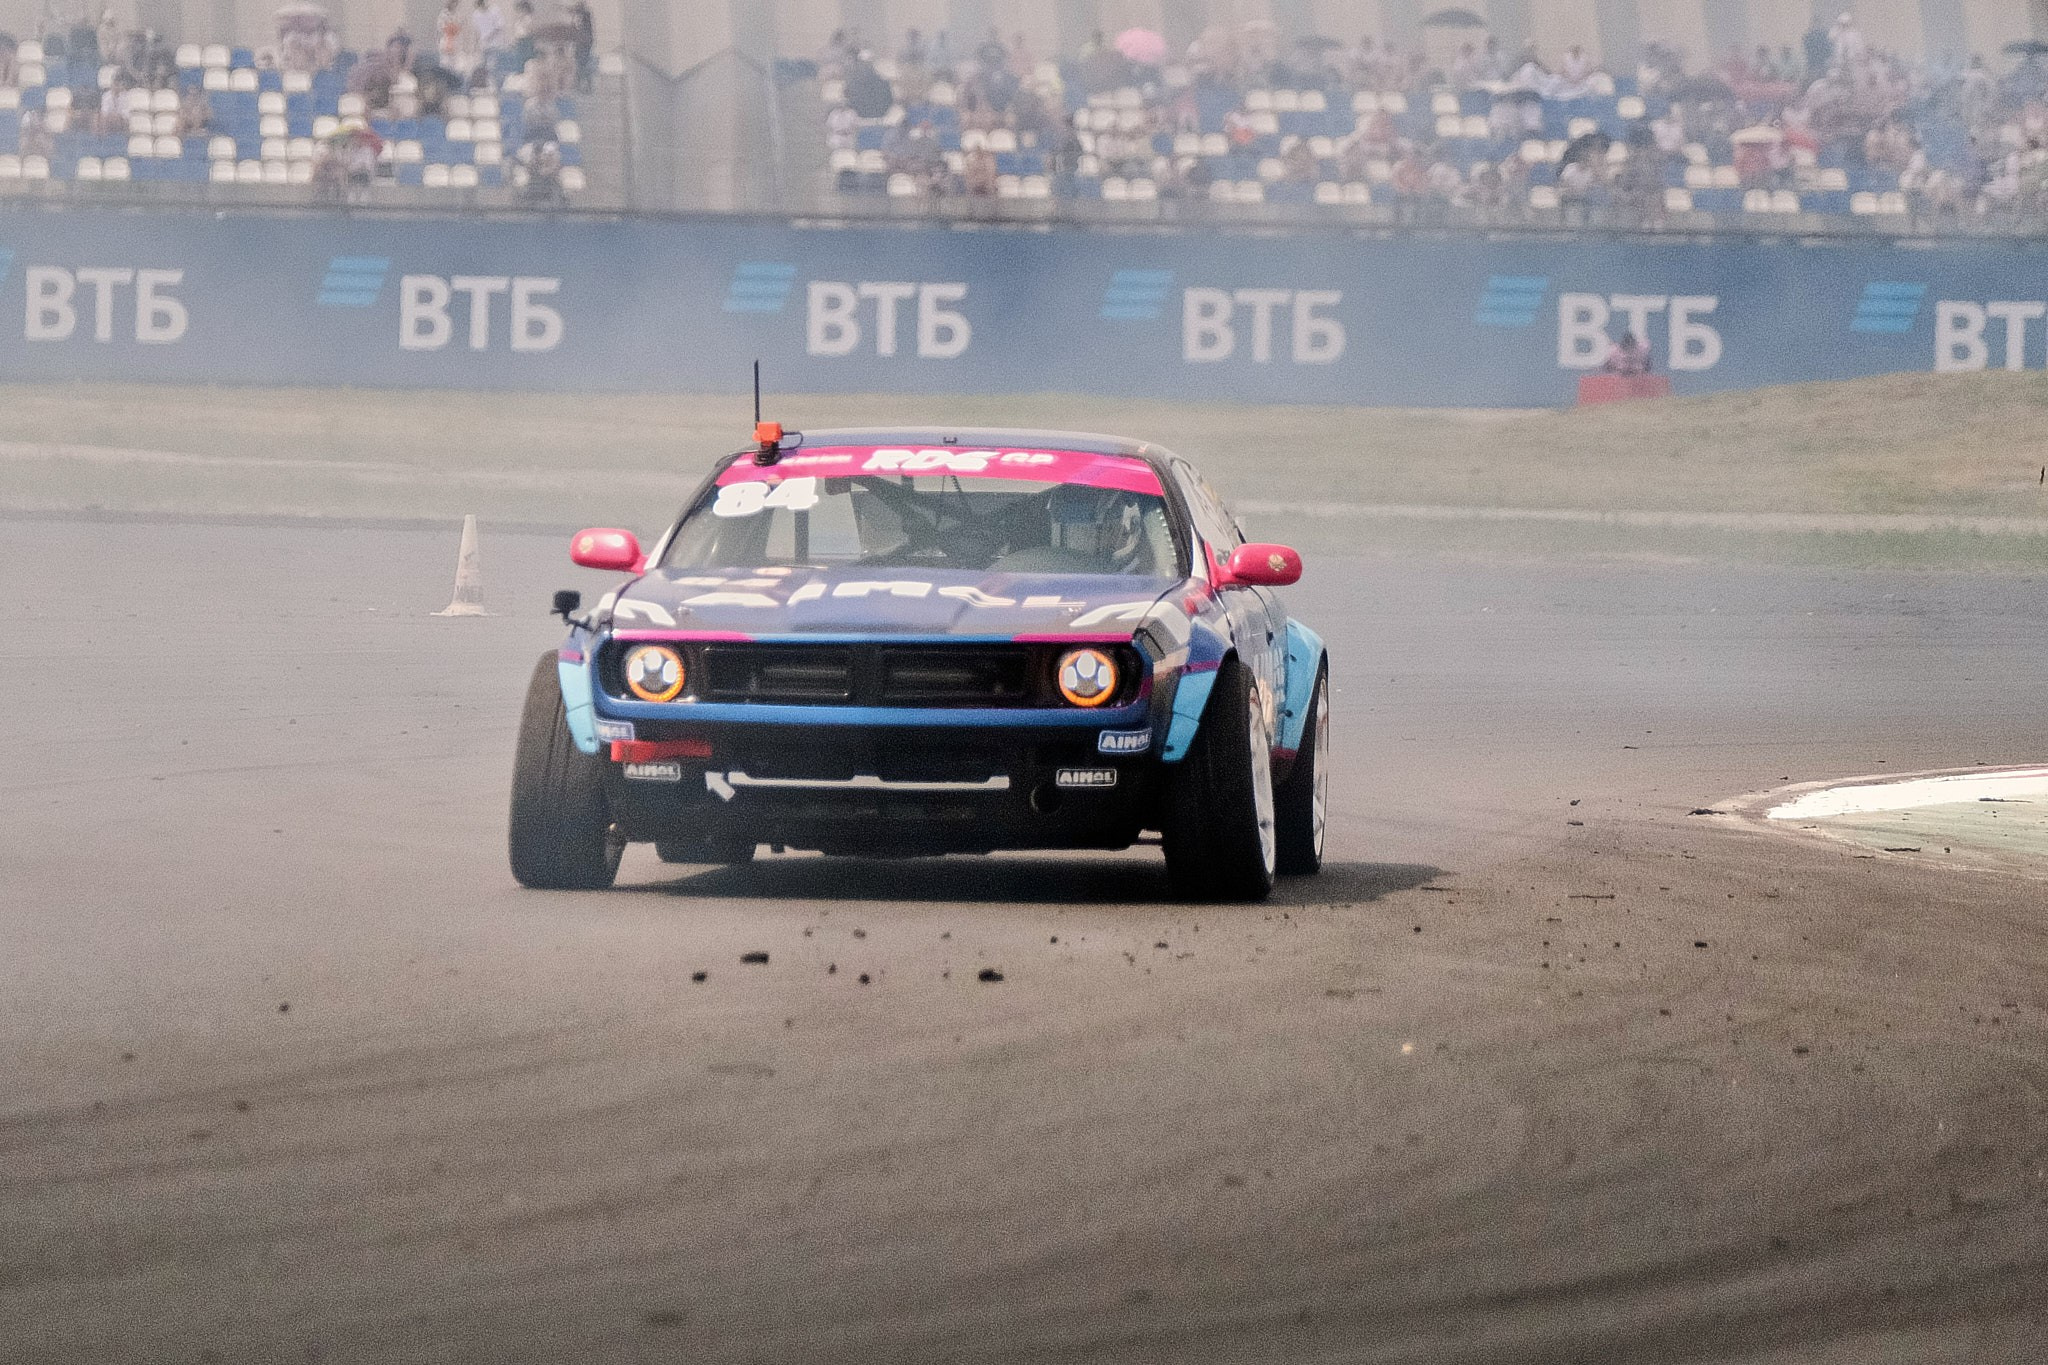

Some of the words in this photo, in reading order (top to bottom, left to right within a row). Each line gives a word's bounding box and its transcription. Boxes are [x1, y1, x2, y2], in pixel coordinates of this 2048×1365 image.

[25, 266, 188, 343] ВТБ
[400, 275, 564, 351] ВТБ
[807, 281, 972, 358] ВТБ
[1183, 287, 1346, 363] ВТБ
[1559, 293, 1722, 370] ВТБ
[1934, 300, 2048, 372] ВТ
[713, 476, 819, 517] 84
[861, 449, 1000, 471] RDS
[1059, 771, 1113, 784] AIMOL
